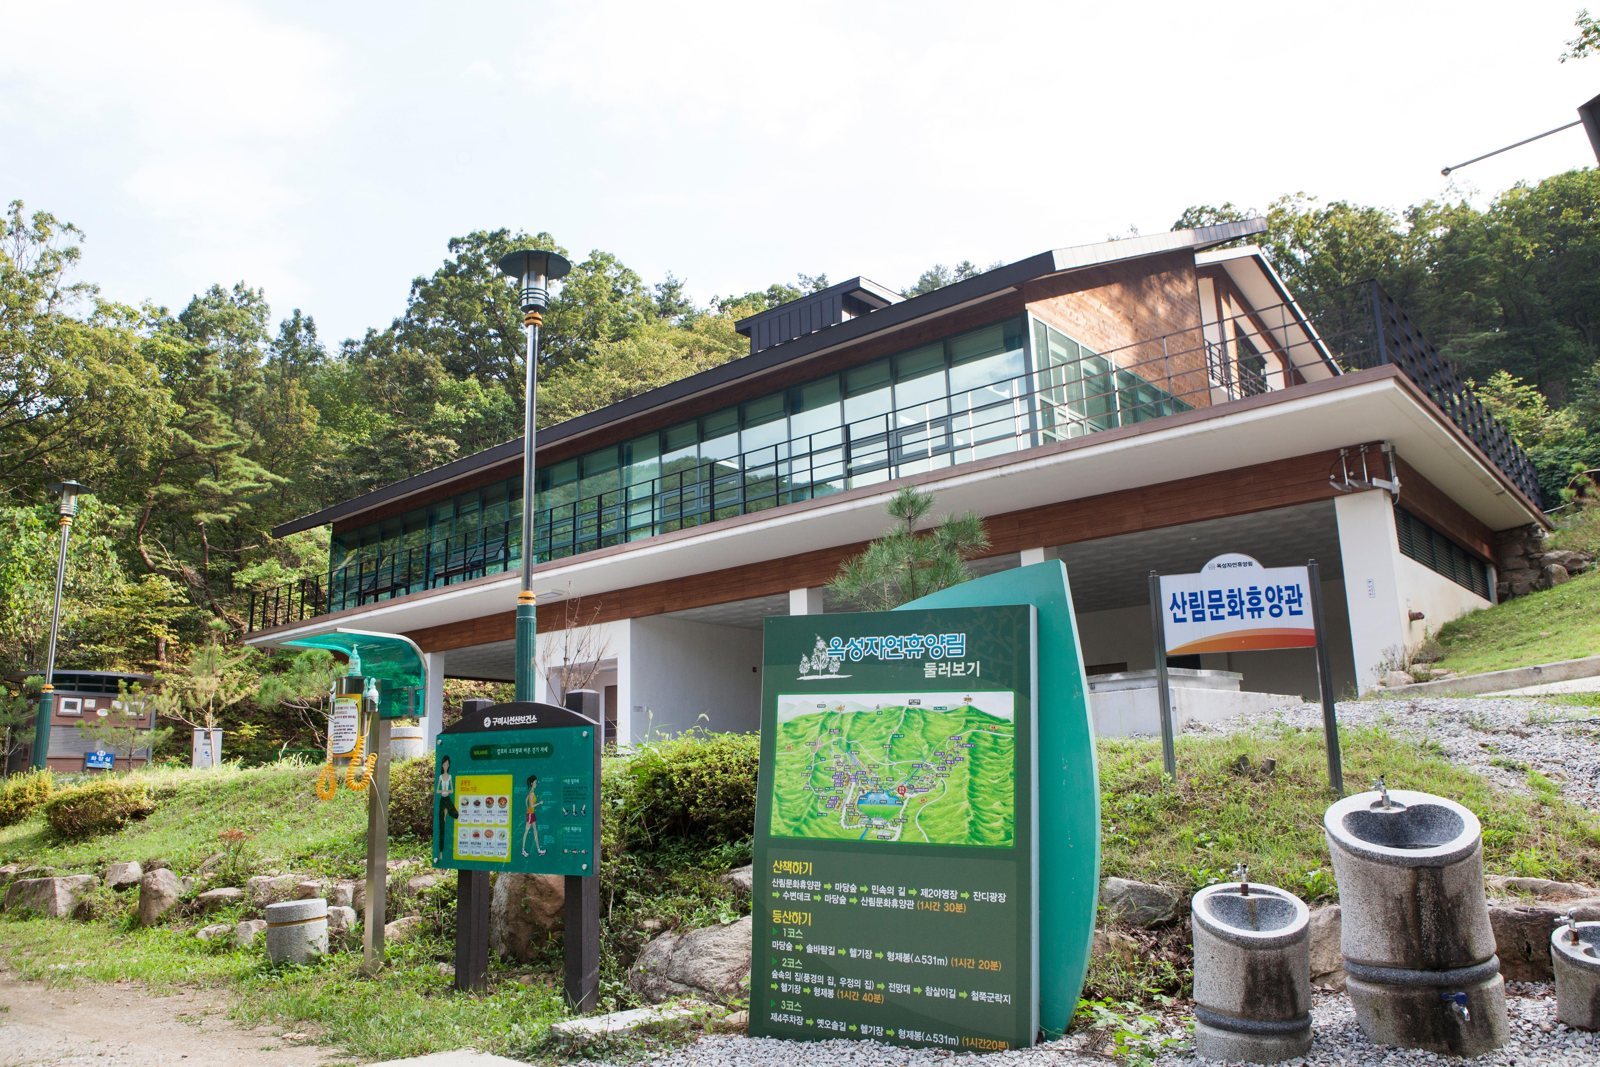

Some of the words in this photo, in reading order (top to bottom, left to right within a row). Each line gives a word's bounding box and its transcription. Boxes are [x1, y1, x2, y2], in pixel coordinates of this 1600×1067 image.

[1169, 583, 1304, 624] 산림문화휴양관
[827, 632, 966, 661] 옥성자연휴양림
[924, 661, 979, 678] 둘러보기
[492, 714, 538, 725] 구미시선산보건소
[773, 860, 812, 875] 산책하기
[772, 878, 821, 892] 산림문화휴양관
[835, 883, 857, 893] 마당숲
[872, 885, 894, 895] 민속의
[898, 887, 905, 896] 길
[921, 888, 958, 900] 제2야영장
[973, 892, 1006, 903] 잔디광장
[783, 891, 811, 901] 수변데크
[825, 894, 846, 904] 마당숲
[861, 897, 914, 909] 산림문화휴양관
[917, 901, 940, 911] (1시간
[944, 903, 966, 913] 30분)
[773, 910, 811, 926] 등산하기
[783, 928, 803, 939] 1코스
[772, 941, 793, 951] 마당숲
[850, 948, 872, 959] 헬기장
[951, 957, 975, 968] (1시간
[979, 960, 1001, 971] 20분)
[782, 958, 802, 969] 2코스
[772, 970, 791, 980] 숲속의
[865, 980, 874, 990] 집)
[889, 983, 910, 994] 전망대
[781, 983, 801, 994] 헬기장
[814, 987, 834, 998] 형제봉
[837, 990, 859, 1001] (1시간
[863, 993, 884, 1003] 40분)
[781, 1000, 801, 1012] 3코스
[771, 1013, 803, 1025] 제4주차장
[861, 1024, 883, 1036] 헬기장
